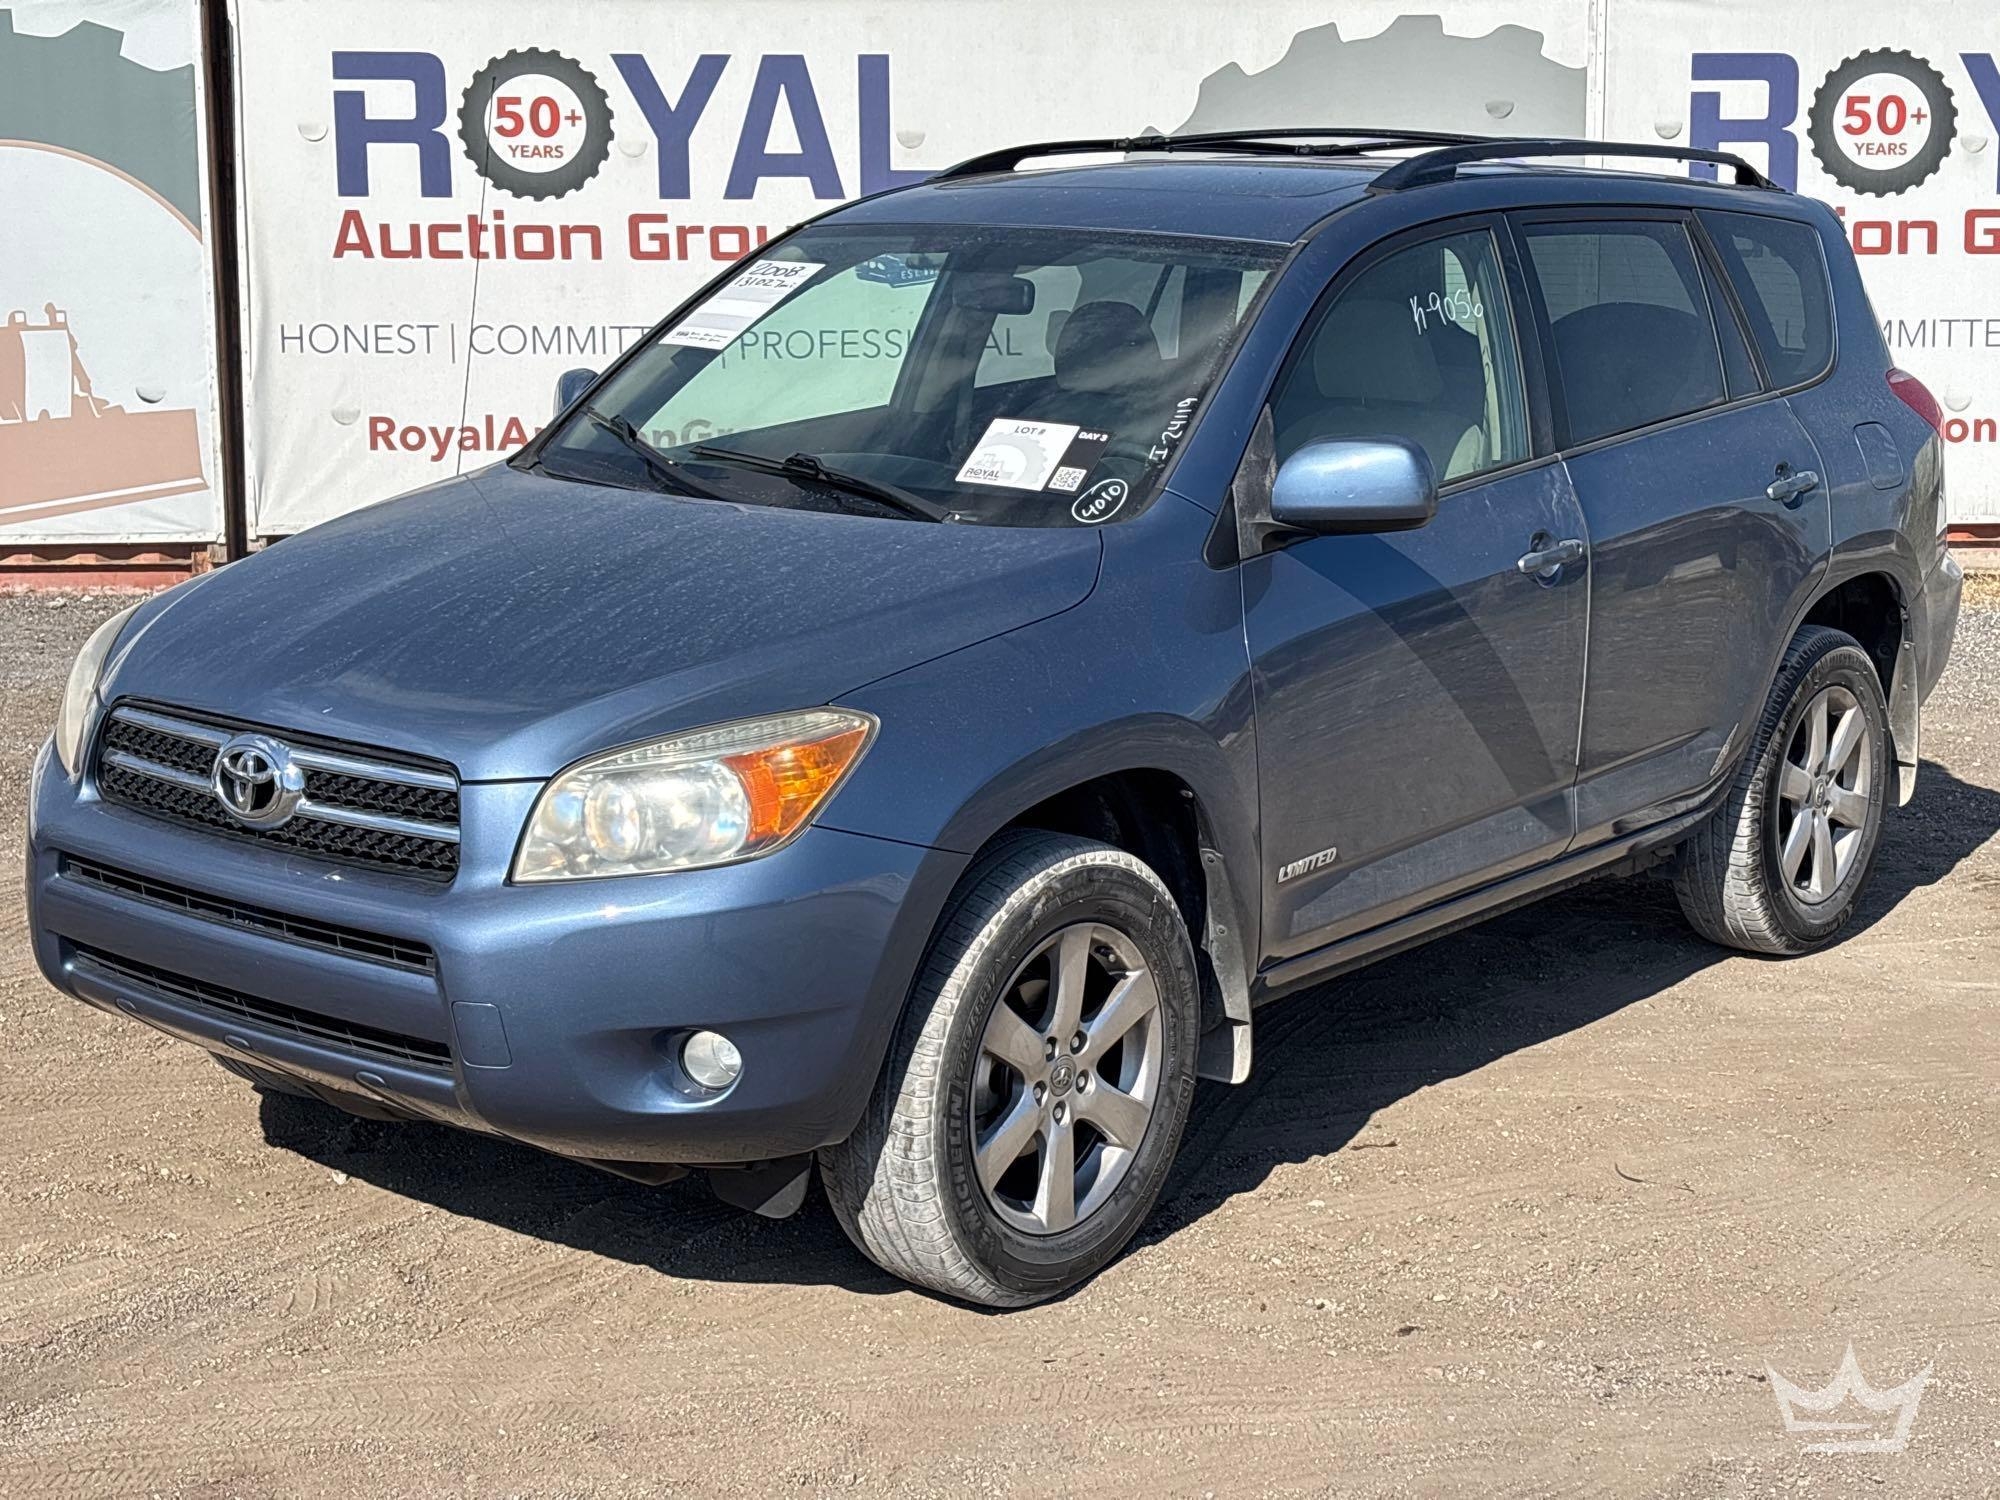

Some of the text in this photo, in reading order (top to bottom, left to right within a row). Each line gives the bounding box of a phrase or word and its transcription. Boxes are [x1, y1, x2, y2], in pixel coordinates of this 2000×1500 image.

[332, 46, 945, 201] ROYAL
[493, 95, 583, 138] 50+
[1842, 94, 1928, 136] 50+
[508, 143, 565, 160] YEARS
[1854, 142, 1908, 156] YEARS
[333, 209, 603, 260] Auction
[749, 262, 806, 278] 2008
[279, 322, 438, 356] HONEST
[1014, 425, 1038, 436] LOT
[1078, 431, 1101, 441] DAY
[965, 467, 1001, 479] ROYAL
[1081, 484, 1122, 518] 4010
[1277, 846, 1338, 884] LIMITED
[949, 1092, 983, 1231] MICHELIN
